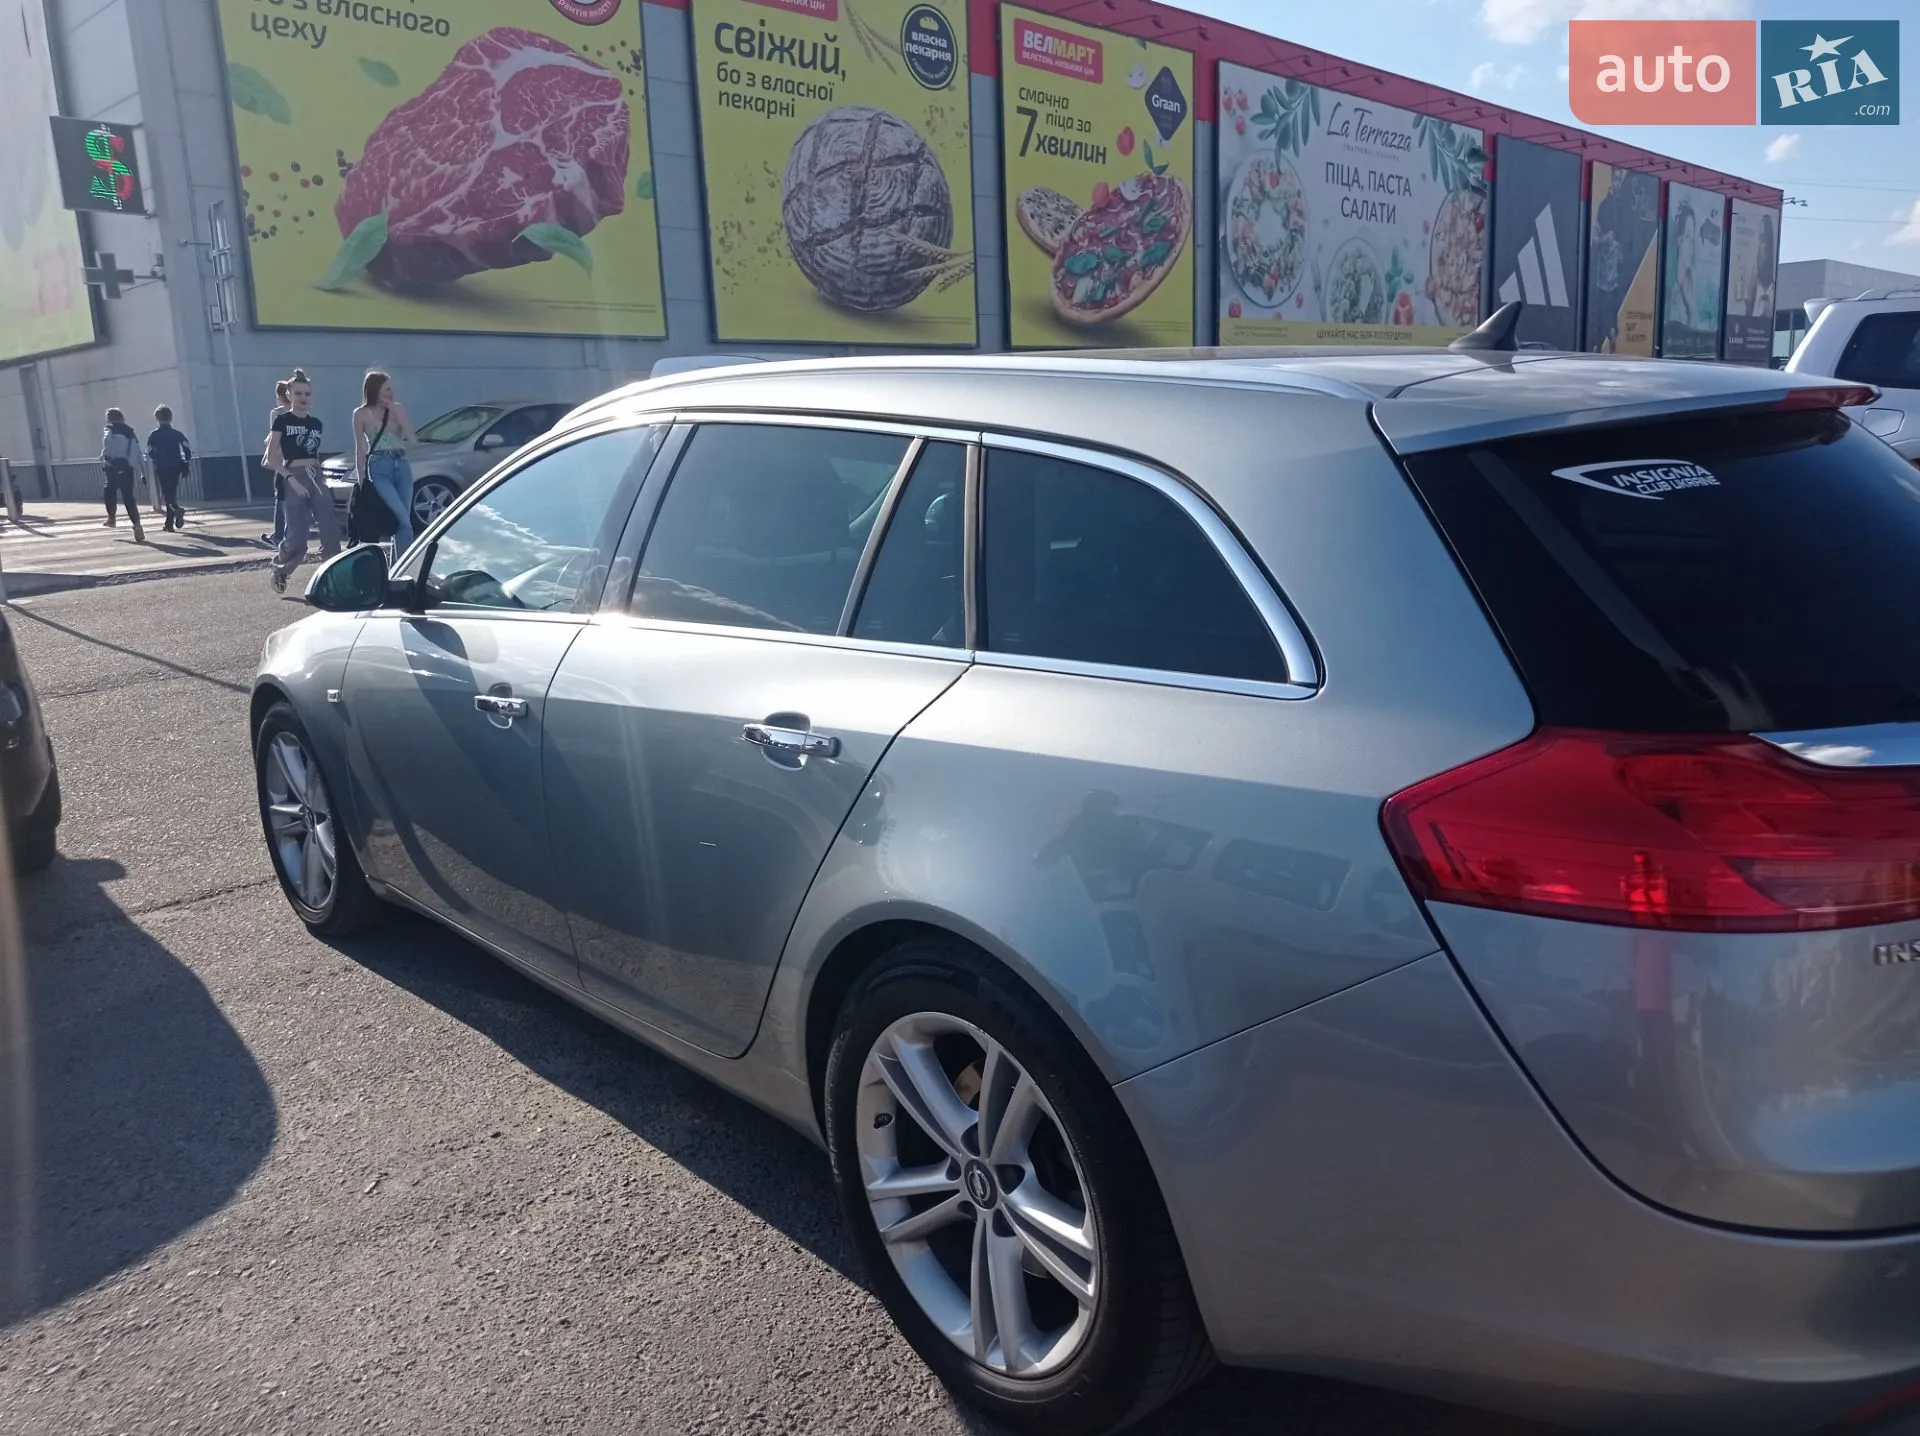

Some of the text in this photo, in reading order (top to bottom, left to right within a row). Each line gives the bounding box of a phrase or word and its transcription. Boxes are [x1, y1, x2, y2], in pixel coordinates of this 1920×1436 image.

[250, 12, 327, 49] цеху
[316, 0, 450, 37] власного
[714, 19, 846, 82] свіжий,
[905, 42, 952, 61] пекарня
[911, 31, 948, 48] власна
[1023, 29, 1096, 65] ВЕЛМАРТ
[717, 61, 835, 102] бо з власної
[718, 90, 796, 119] пекарні
[1018, 87, 1070, 110] смачна
[1151, 94, 1181, 113] Graan
[1016, 105, 1107, 165] 7 хвилин
[1045, 110, 1092, 133] піца за
[1326, 101, 1351, 139] La
[1353, 107, 1412, 152] Terrazza
[1325, 161, 1412, 198] ПІЦА, ПАСТА
[1340, 196, 1396, 224] САЛАТИ
[1612, 464, 1712, 487] INSIGNIA
[1636, 475, 1721, 495] CLUB UKRAINE
